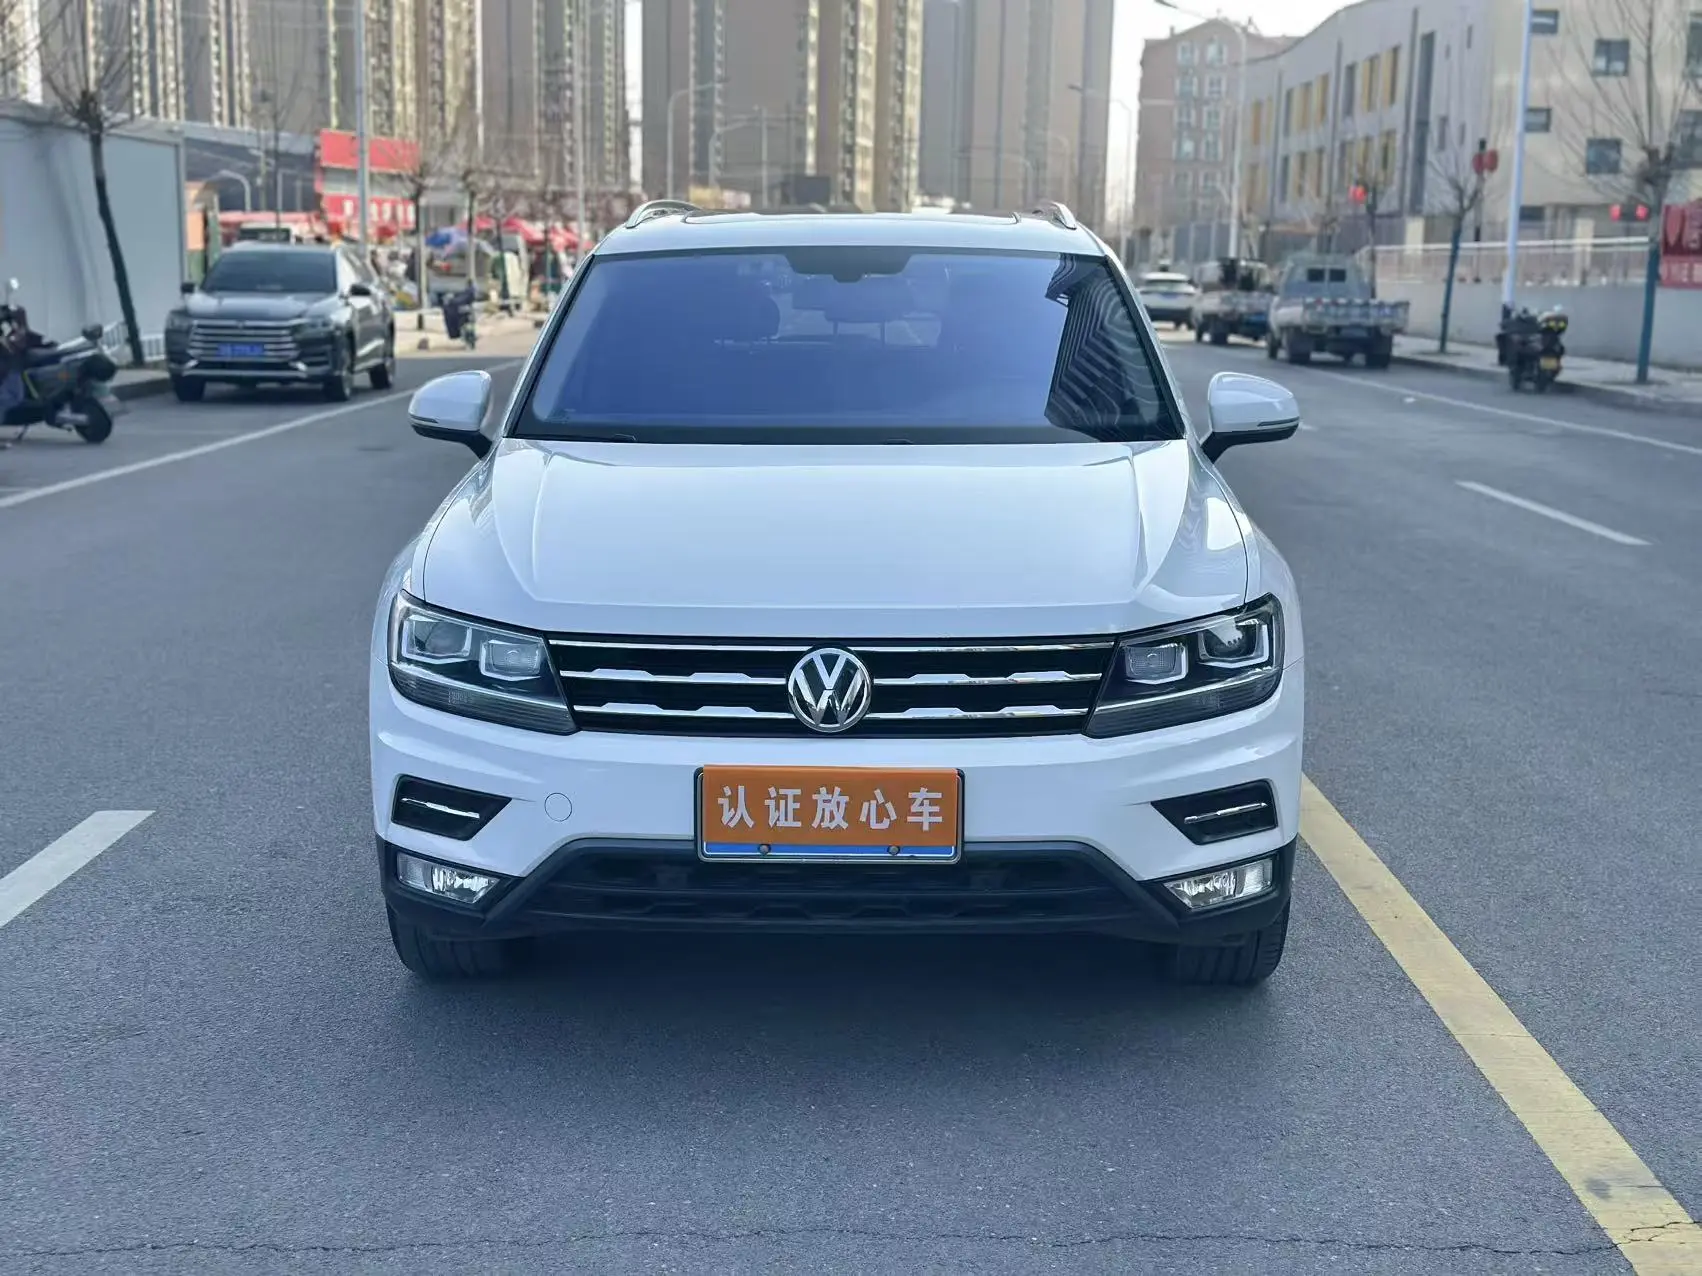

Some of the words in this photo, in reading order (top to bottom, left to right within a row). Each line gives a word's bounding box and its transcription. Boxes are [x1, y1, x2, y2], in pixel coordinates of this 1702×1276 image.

[717, 785, 943, 831] 认证放心车
